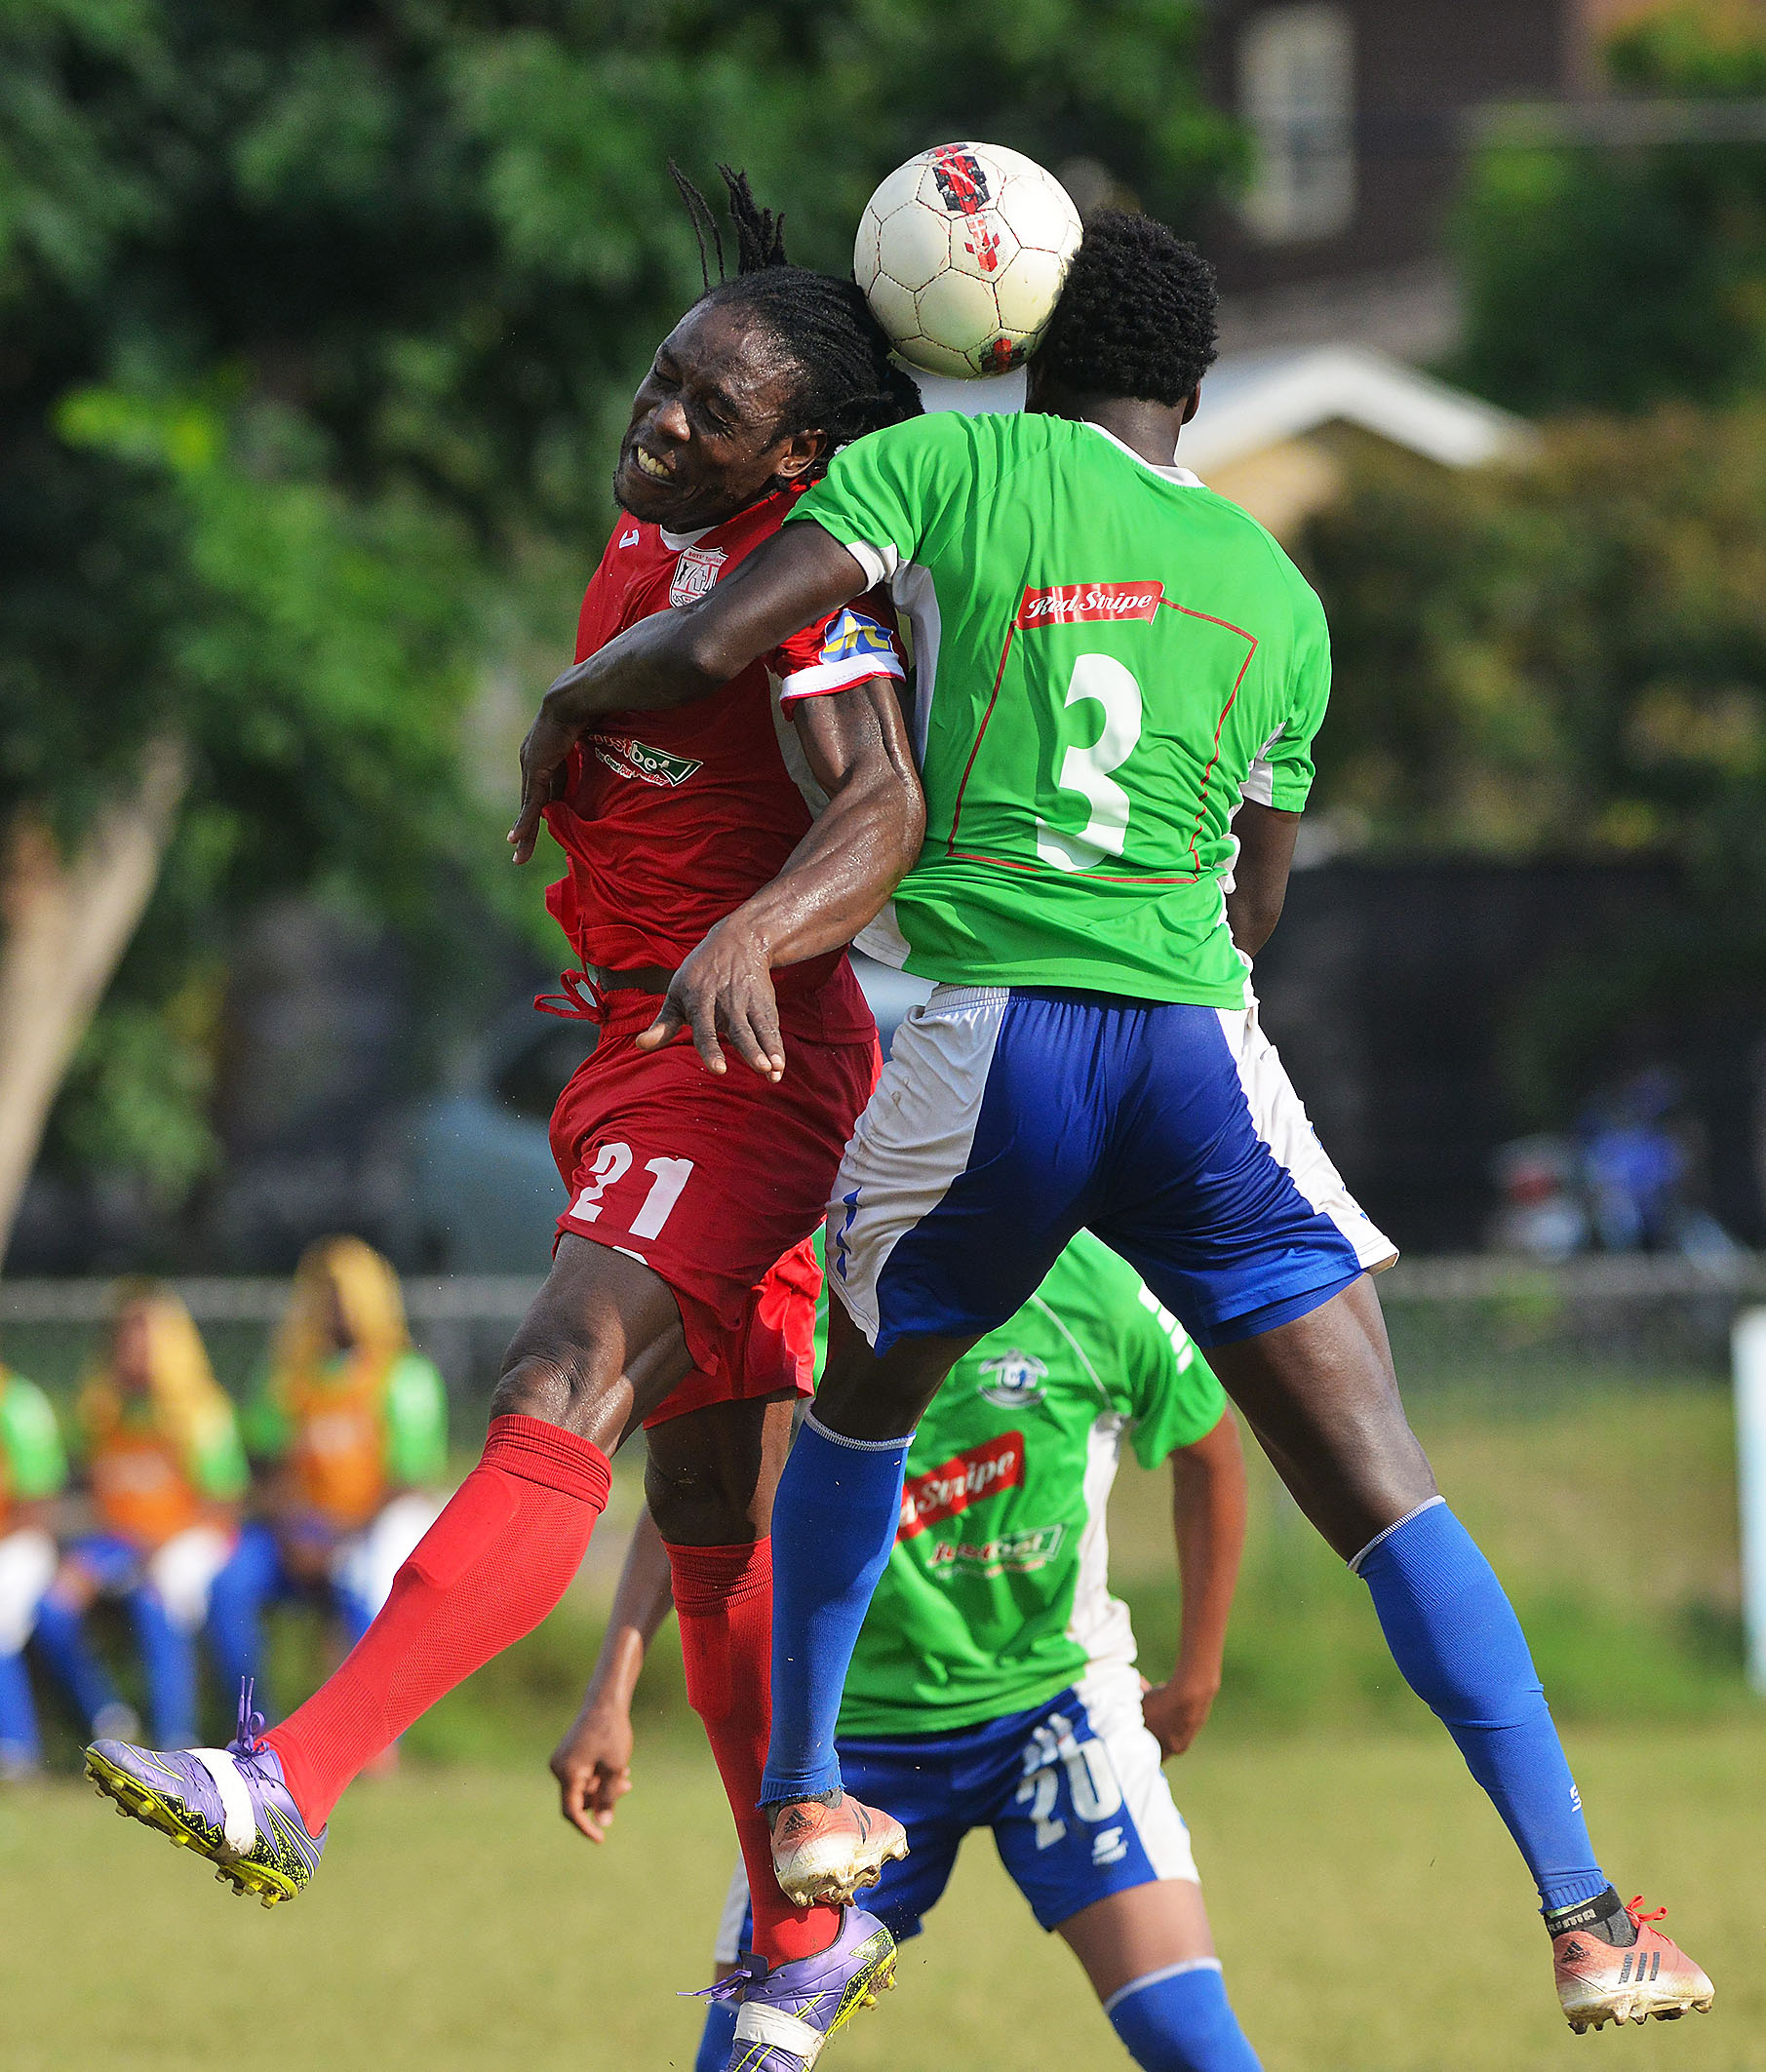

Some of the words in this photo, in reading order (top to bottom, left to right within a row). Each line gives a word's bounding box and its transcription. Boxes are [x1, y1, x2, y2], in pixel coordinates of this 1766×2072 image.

[1025, 595, 1079, 619] Red
[1079, 591, 1153, 613] Stripe
[1036, 652, 1143, 872] 3
[569, 1142, 694, 1240] 21
[1015, 1737, 1123, 1851] 20
